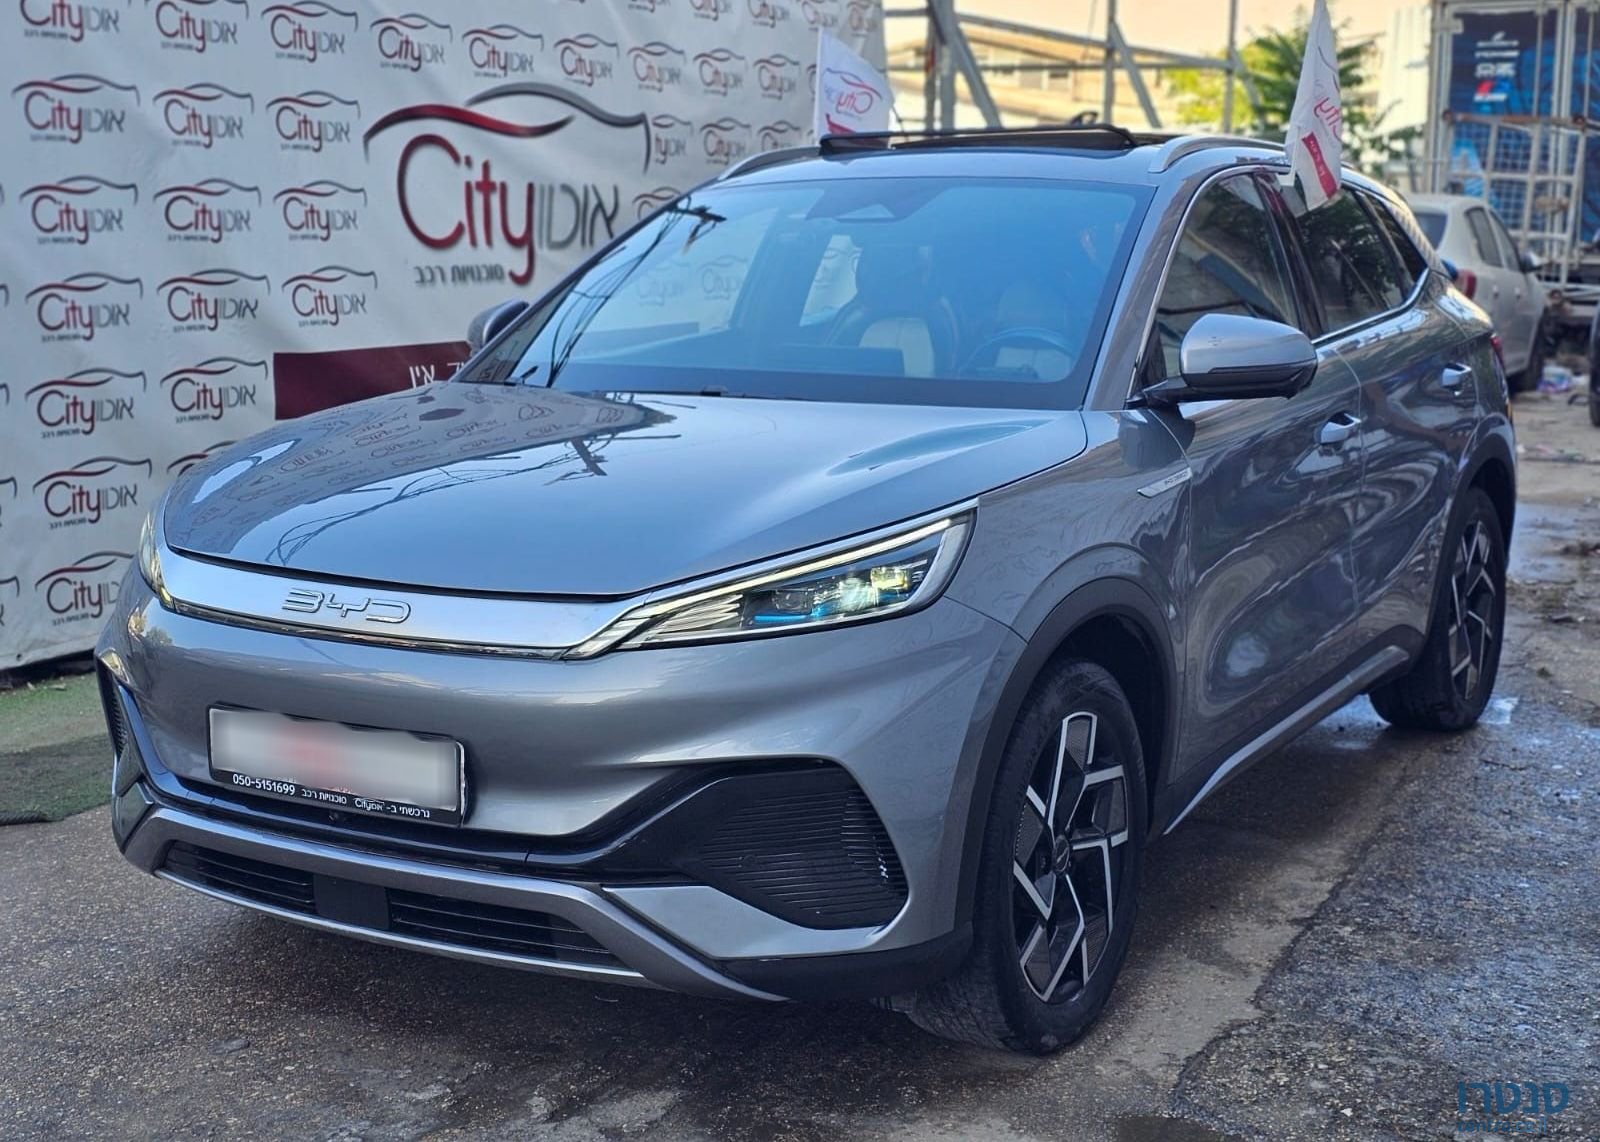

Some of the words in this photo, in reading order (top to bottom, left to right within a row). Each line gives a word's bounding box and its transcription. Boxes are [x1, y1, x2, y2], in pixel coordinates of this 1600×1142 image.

[156, 1, 206, 52] City
[270, 14, 317, 62] City
[378, 26, 422, 72] City
[469, 37, 507, 77] City
[560, 46, 593, 87] City
[24, 91, 82, 144] City
[164, 99, 213, 149] City
[275, 106, 322, 153] City
[32, 195, 88, 245] City
[165, 195, 222, 243] City
[283, 197, 330, 241] City
[397, 134, 535, 286] City
[537, 183, 620, 249] אוטו
[413, 265, 446, 284] רכב
[37, 293, 94, 341] City
[168, 286, 218, 331] City
[292, 283, 339, 325] City
[37, 389, 96, 435] City
[171, 377, 223, 420] City
[44, 480, 101, 524] City
[47, 577, 103, 618] City
[281, 587, 411, 624] BYD
[232, 773, 296, 796] 050-5151699
[301, 788, 317, 799] רכב
[399, 806, 430, 818] נרכשתי
